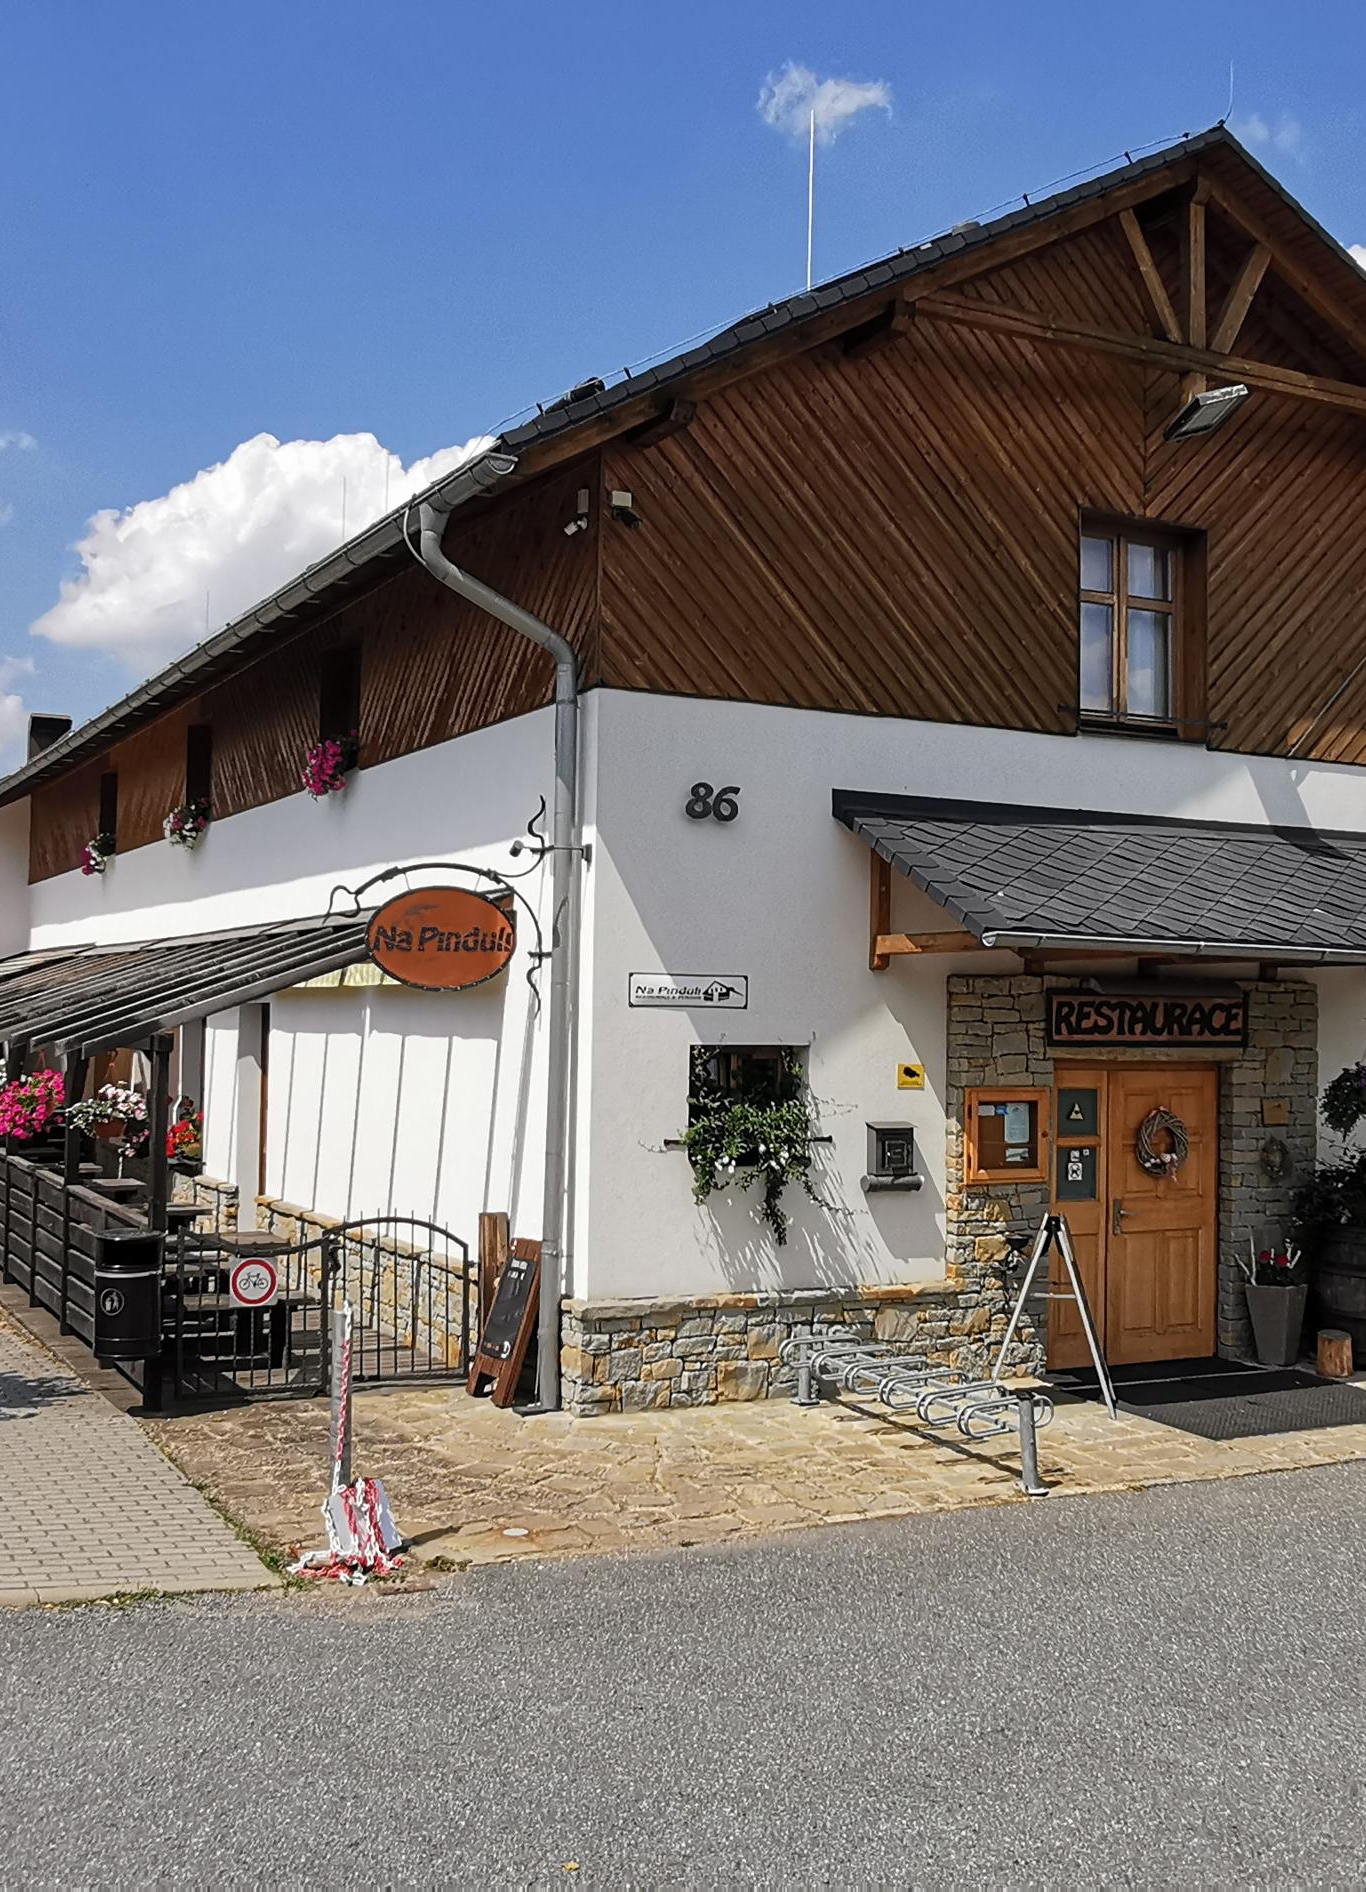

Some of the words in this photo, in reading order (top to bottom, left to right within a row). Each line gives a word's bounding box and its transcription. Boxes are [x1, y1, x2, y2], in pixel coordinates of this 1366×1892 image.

[686, 782, 740, 822] 86
[374, 926, 412, 952] Na
[635, 986, 654, 994] Na
[658, 987, 702, 996] Pinduli
[1054, 1001, 1244, 1036] RESTAURACE
